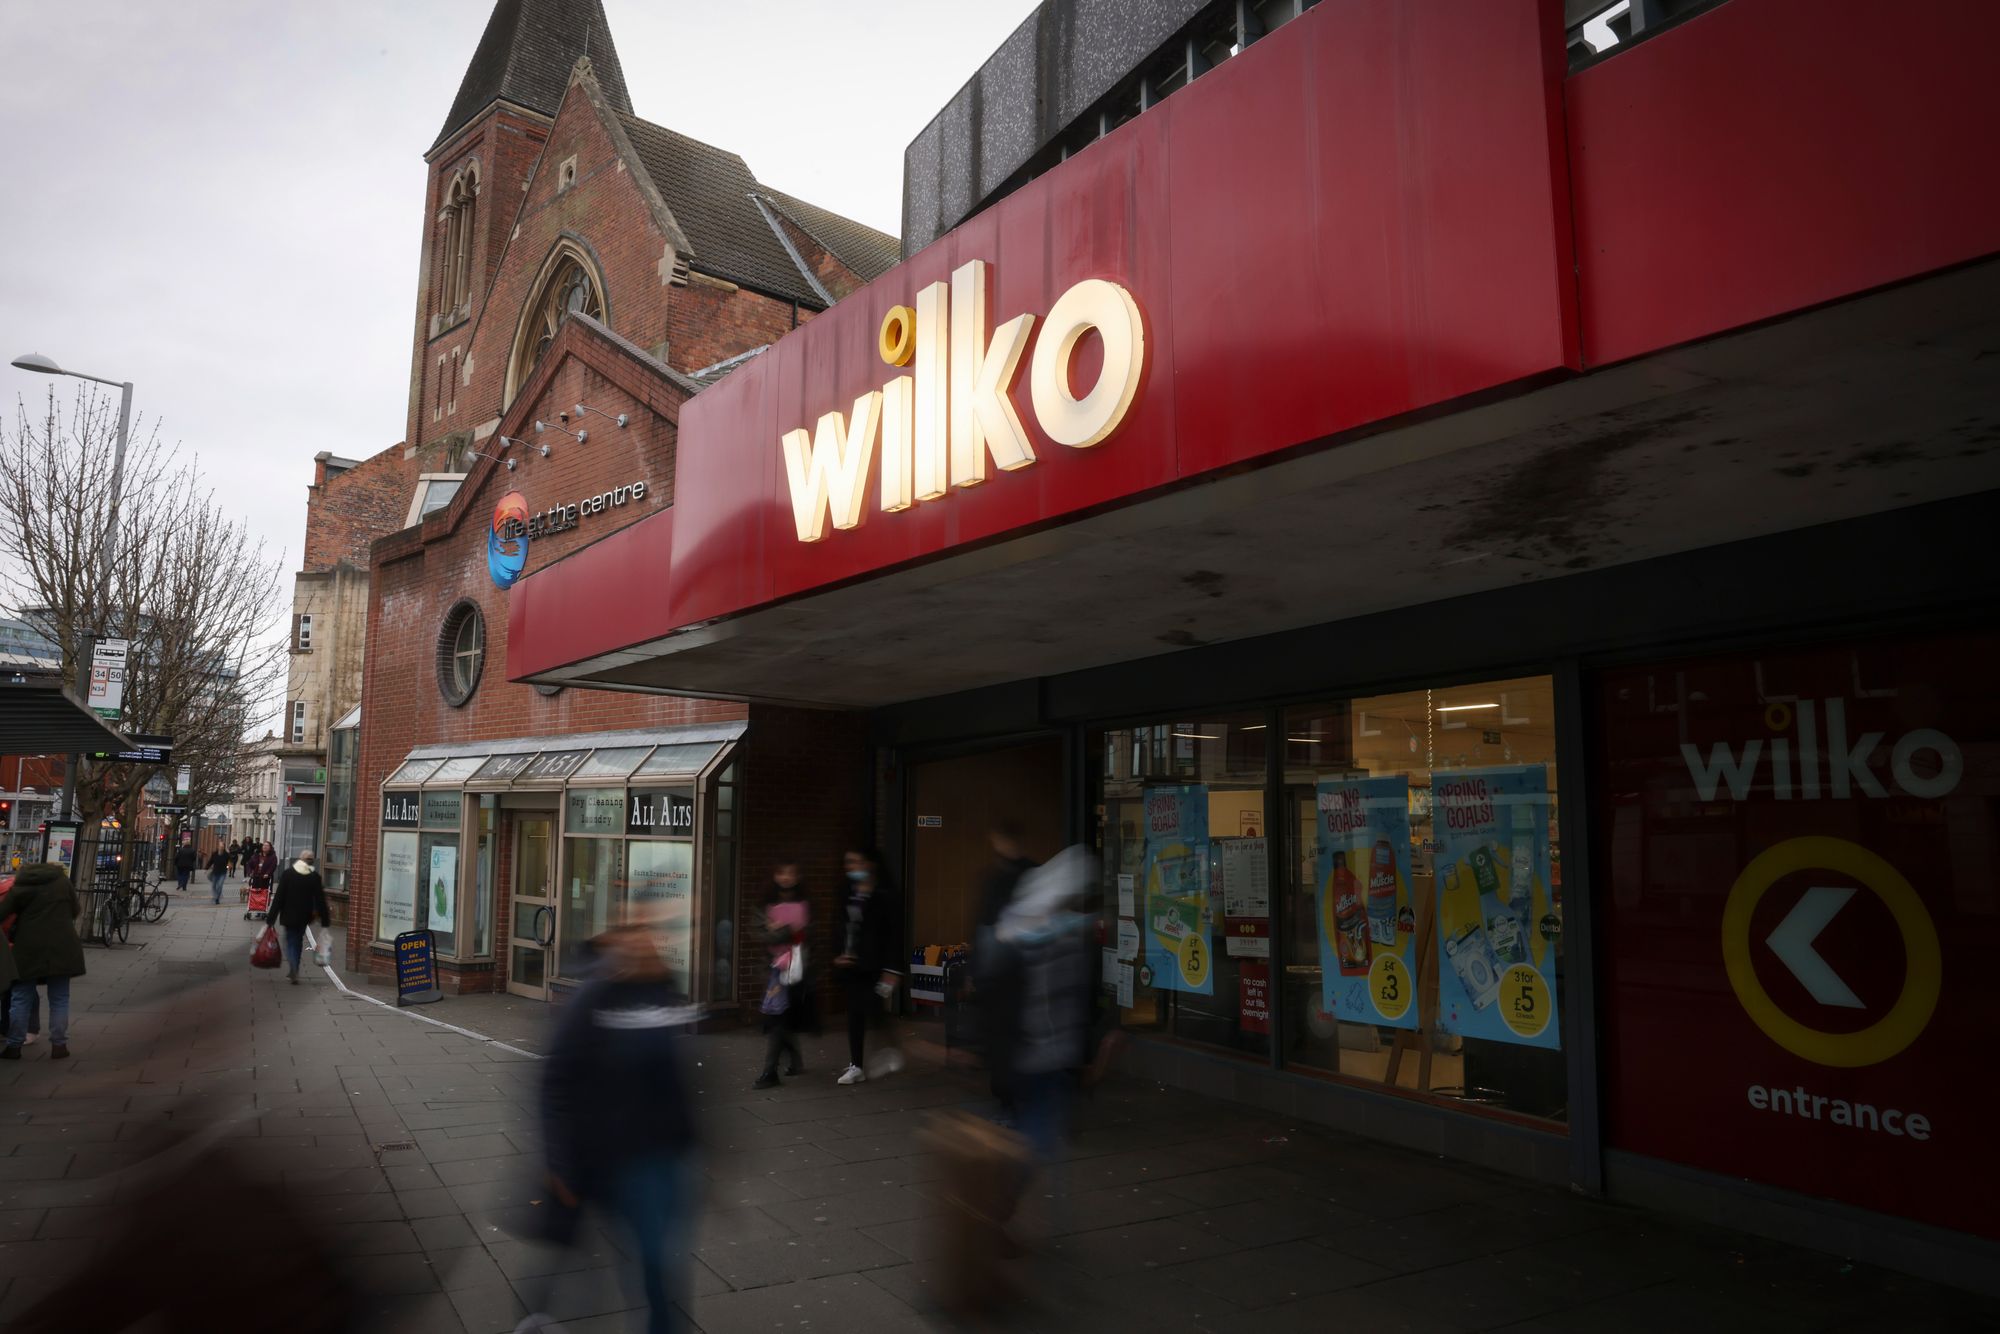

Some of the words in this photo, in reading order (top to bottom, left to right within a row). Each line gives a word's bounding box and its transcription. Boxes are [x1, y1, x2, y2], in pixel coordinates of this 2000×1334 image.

[782, 259, 1144, 542] wilko
[528, 512, 545, 531] at
[548, 502, 577, 526] the
[581, 481, 645, 517] centre
[95, 670, 105, 678] 34
[111, 671, 121, 679] 50
[1680, 697, 1964, 801] wilko
[571, 797, 585, 809] Dry
[588, 796, 624, 809] Cleaning
[1322, 787, 1361, 813] SPRING
[1438, 778, 1489, 808] SPRING
[1147, 794, 1177, 817] SPRING
[1446, 802, 1495, 829] GOALS!
[581, 813, 612, 826] Laundry
[1151, 811, 1179, 832] GOALS!
[1328, 809, 1367, 833] GOALS!
[1370, 875, 1394, 889] Muscle
[401, 940, 426, 951] OPEN
[1187, 949, 1201, 972] £5
[1252, 978, 1267, 988] cash
[1381, 975, 1399, 1001] £3
[1514, 971, 1521, 983] 3
[1521, 971, 1534, 983] for
[1513, 986, 1535, 1012] £5
[1746, 1082, 1933, 1143] entrance
